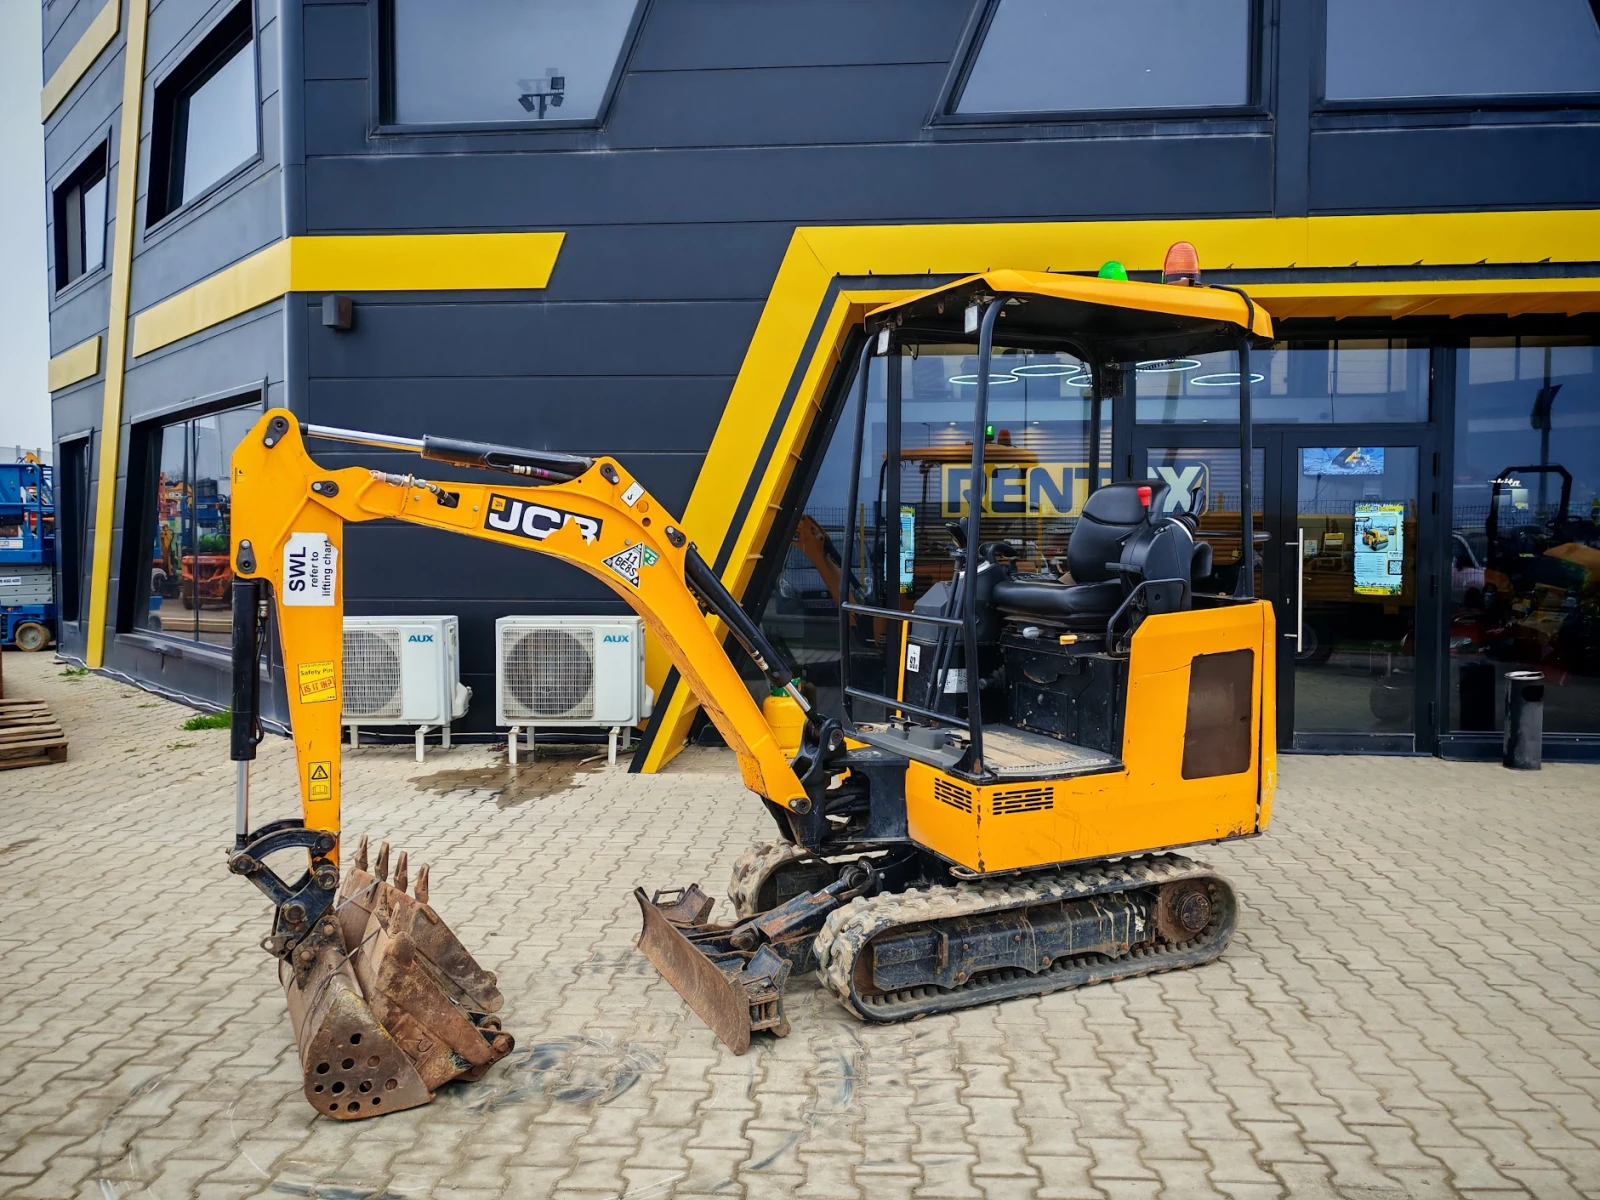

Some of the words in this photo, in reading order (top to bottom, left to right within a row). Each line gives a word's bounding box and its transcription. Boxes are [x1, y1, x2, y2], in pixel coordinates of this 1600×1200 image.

[947, 466, 1202, 513] RENTX
[310, 551, 319, 561] to
[322, 540, 332, 565] chart
[625, 552, 638, 565] 11
[288, 546, 306, 592] SWL
[309, 564, 319, 588] refer
[322, 568, 333, 597] lifting
[407, 634, 434, 643] AUX
[602, 634, 629, 643] AUX
[303, 684, 312, 693] IS
[312, 682, 319, 691] IT
